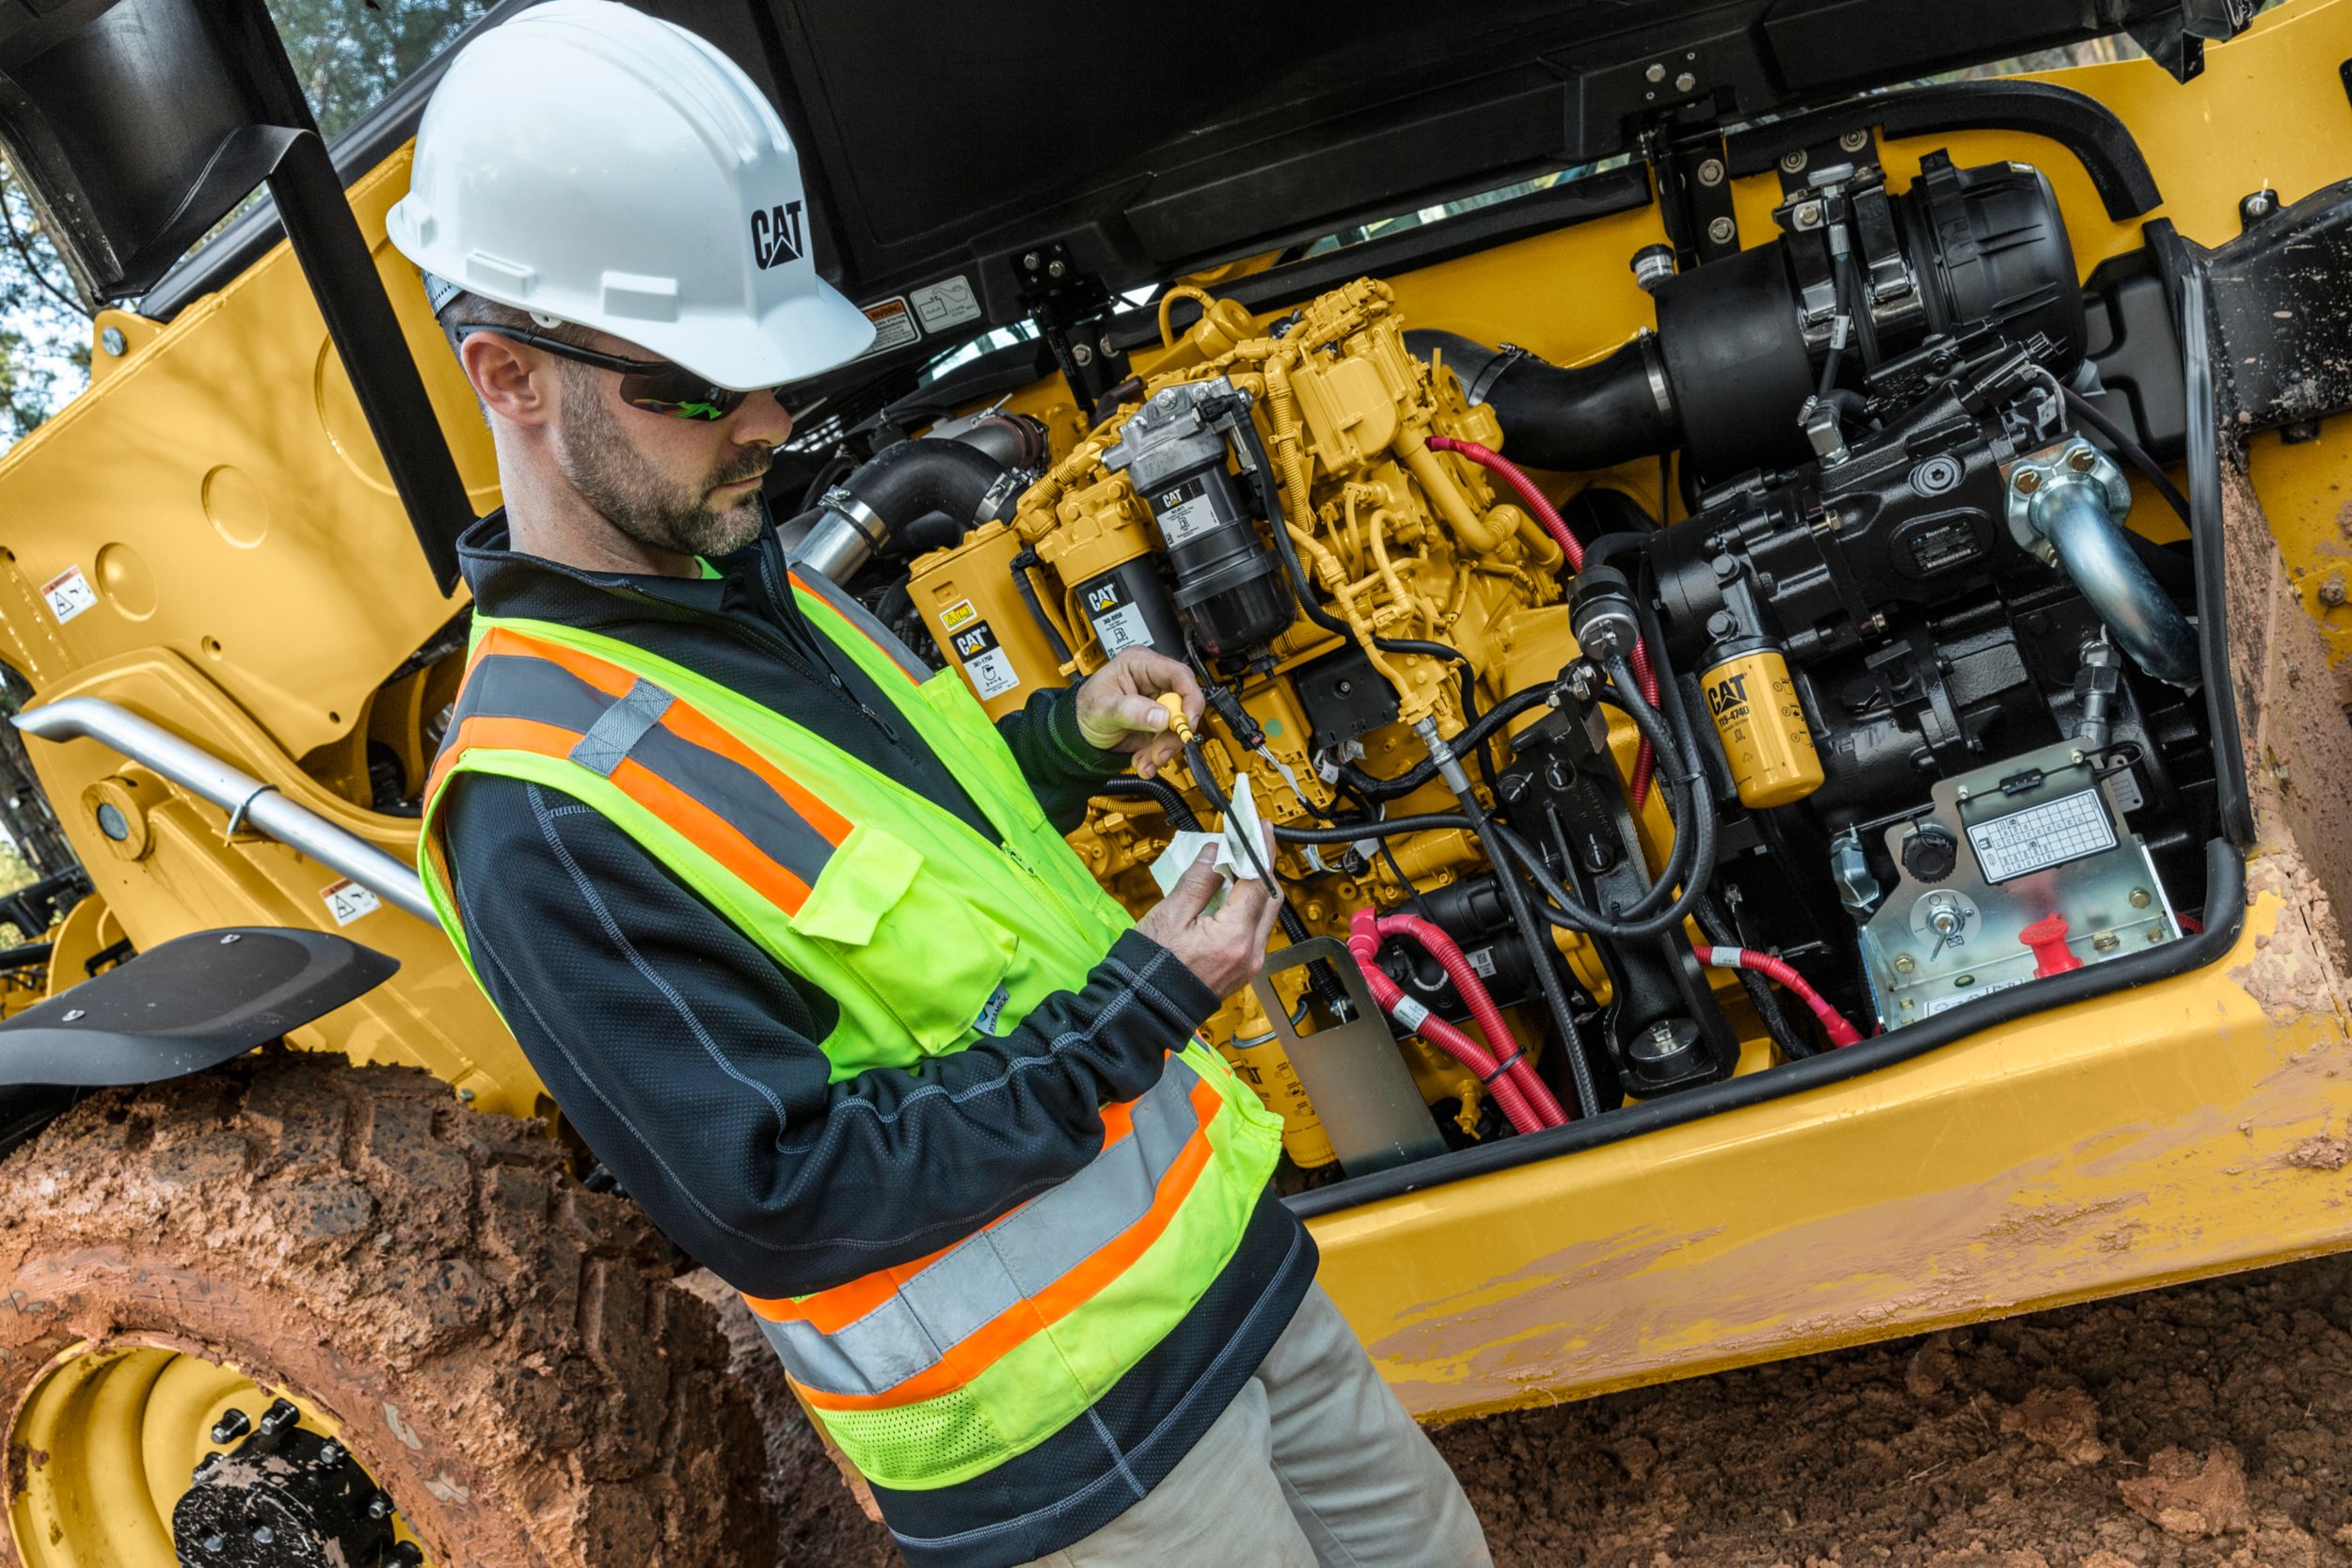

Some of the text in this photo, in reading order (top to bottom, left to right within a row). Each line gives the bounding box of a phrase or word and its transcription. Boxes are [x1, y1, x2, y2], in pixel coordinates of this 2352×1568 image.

[751, 200, 803, 270] CAT
[1163, 489, 1183, 508] CAT
[1088, 583, 1119, 611] CAT
[957, 628, 987, 657] CAT
[1708, 673, 1748, 716] CAT
[1718, 705, 1750, 727] 119-4740
[989, 994, 1008, 1033] PYRAMEX
